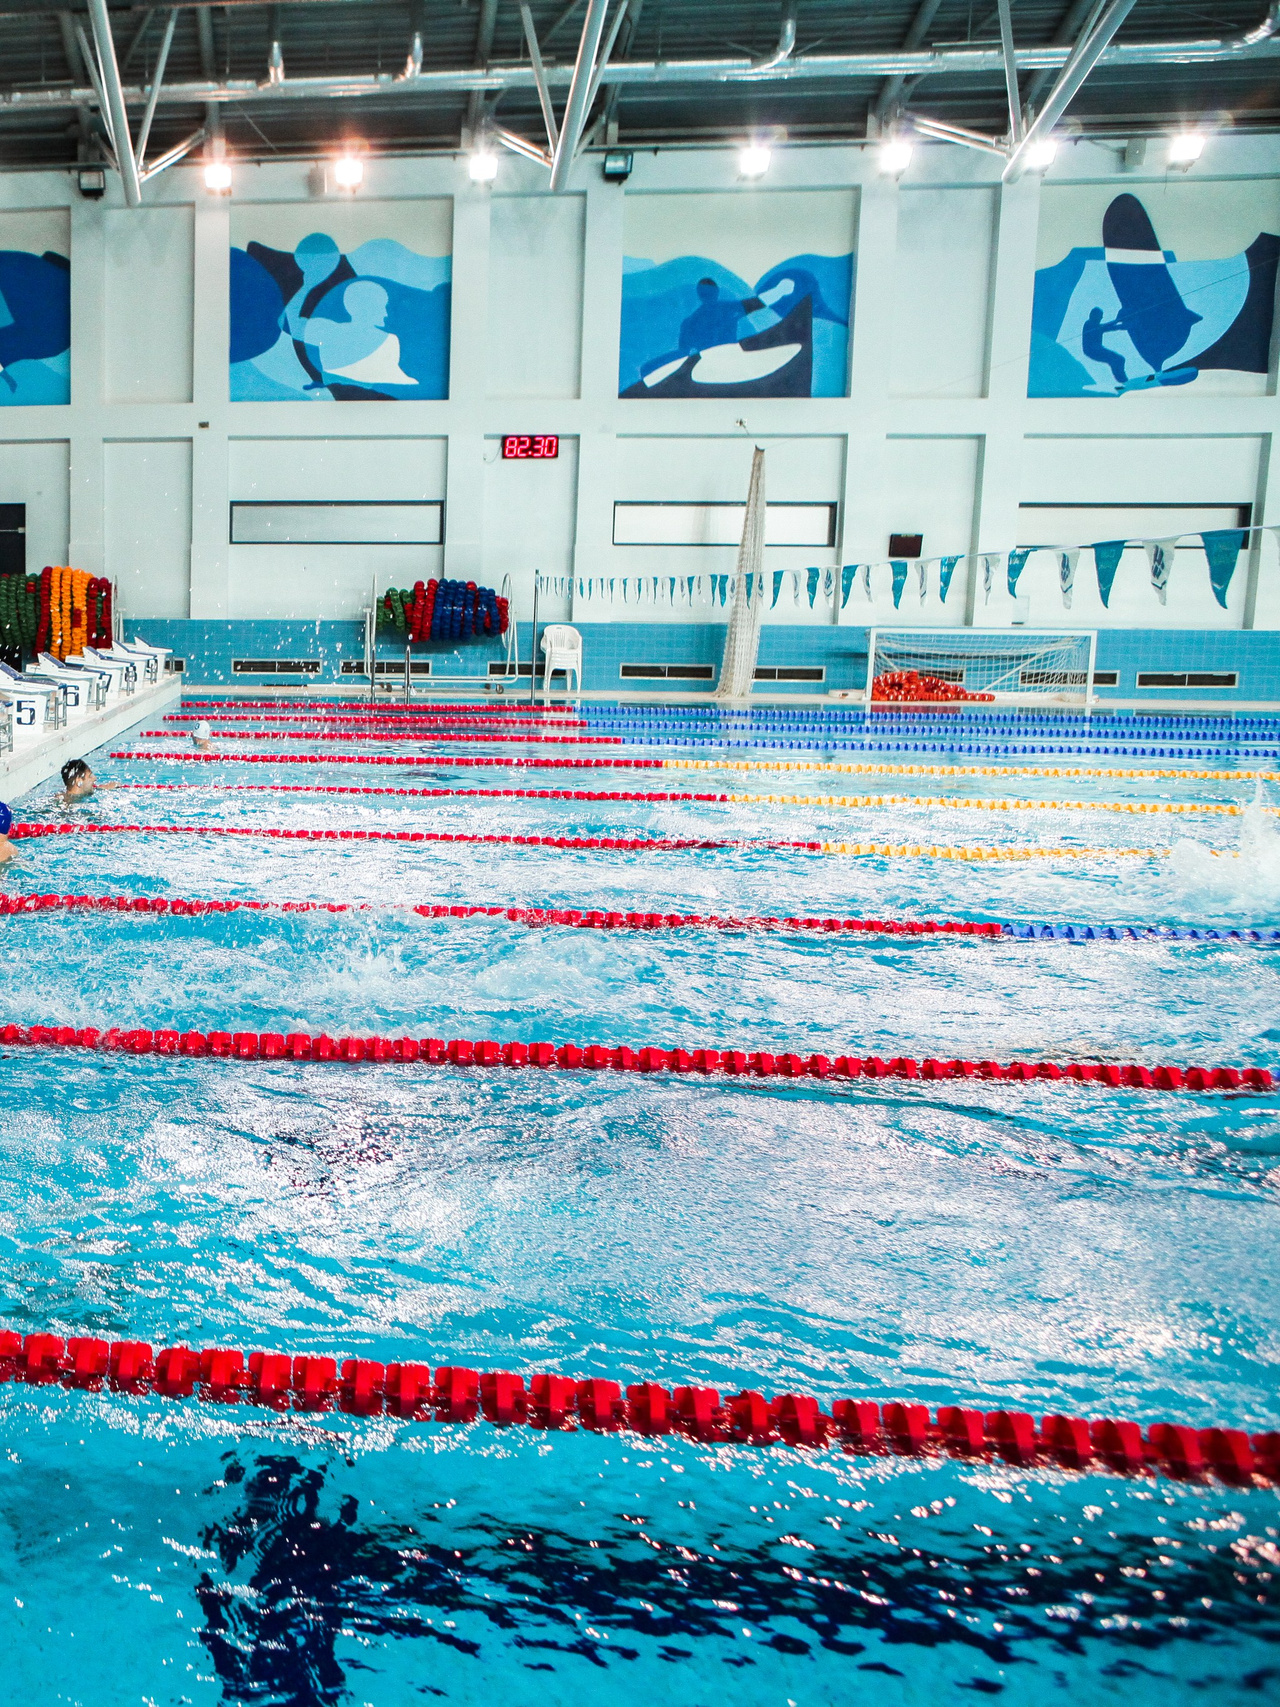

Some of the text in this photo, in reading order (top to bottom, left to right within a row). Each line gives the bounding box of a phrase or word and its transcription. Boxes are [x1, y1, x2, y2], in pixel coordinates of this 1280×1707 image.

[505, 435, 557, 457] 82.30
[63, 685, 79, 706] 6
[16, 700, 36, 726] 5
